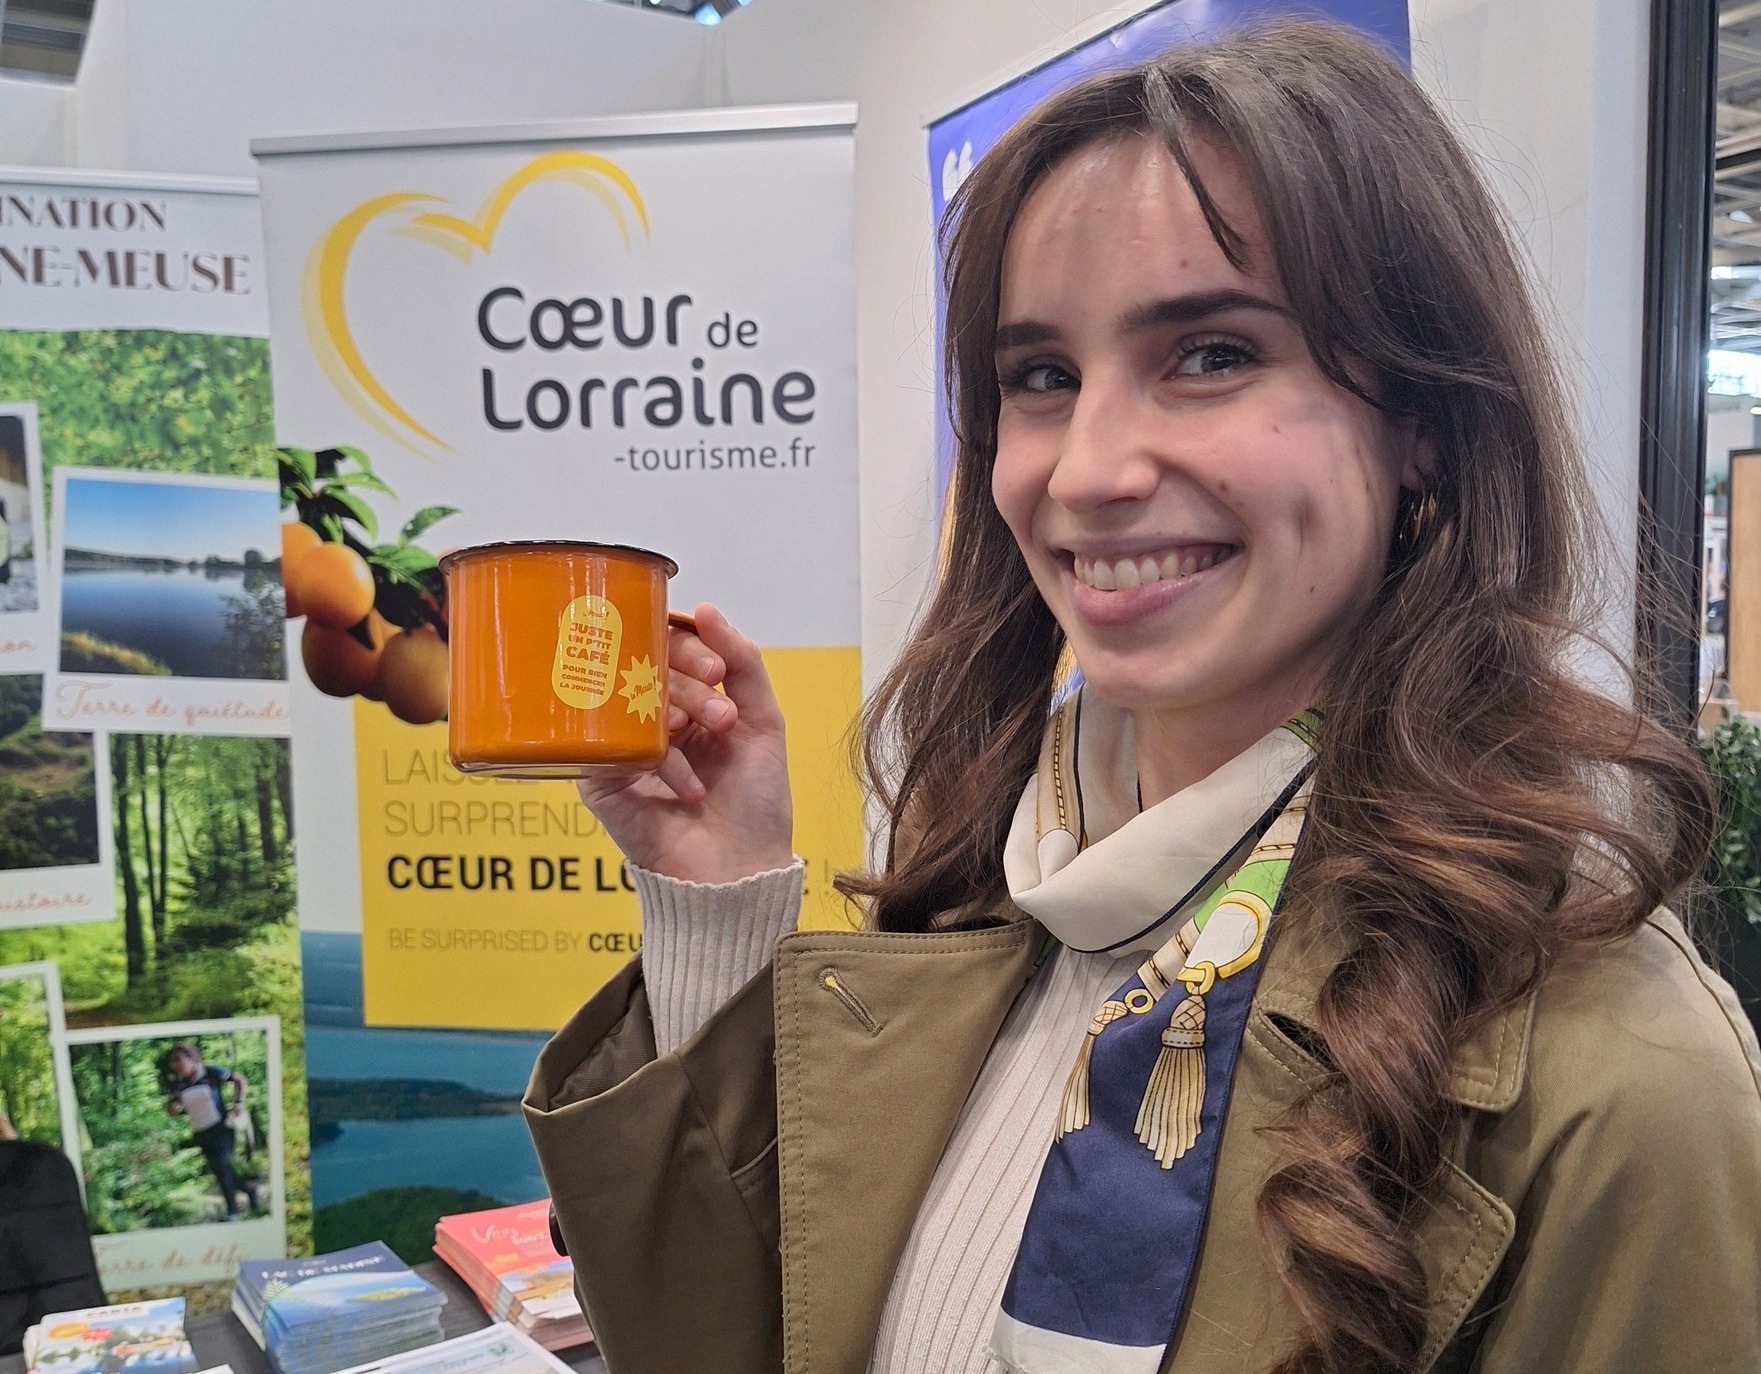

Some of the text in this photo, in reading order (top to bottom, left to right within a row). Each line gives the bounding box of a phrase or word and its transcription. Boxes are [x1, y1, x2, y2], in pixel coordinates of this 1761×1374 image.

[478, 286, 759, 350] Cœur de
[482, 357, 816, 431] Lorraine
[614, 437, 816, 471] -tourisme.fr
[568, 634, 584, 646] UN
[569, 622, 614, 641] JUSTE
[565, 645, 610, 666] CAFÉ
[561, 673, 606, 687] COMMENCER
[562, 663, 608, 679] POUR BIEN
[559, 681, 570, 689] LA
[144, 695, 175, 717] de
[385, 800, 607, 838] SURPREND
[388, 854, 515, 891] CŒUR
[530, 857, 580, 891] DE
[388, 927, 643, 952] BE SURPRISED BY CŒU
